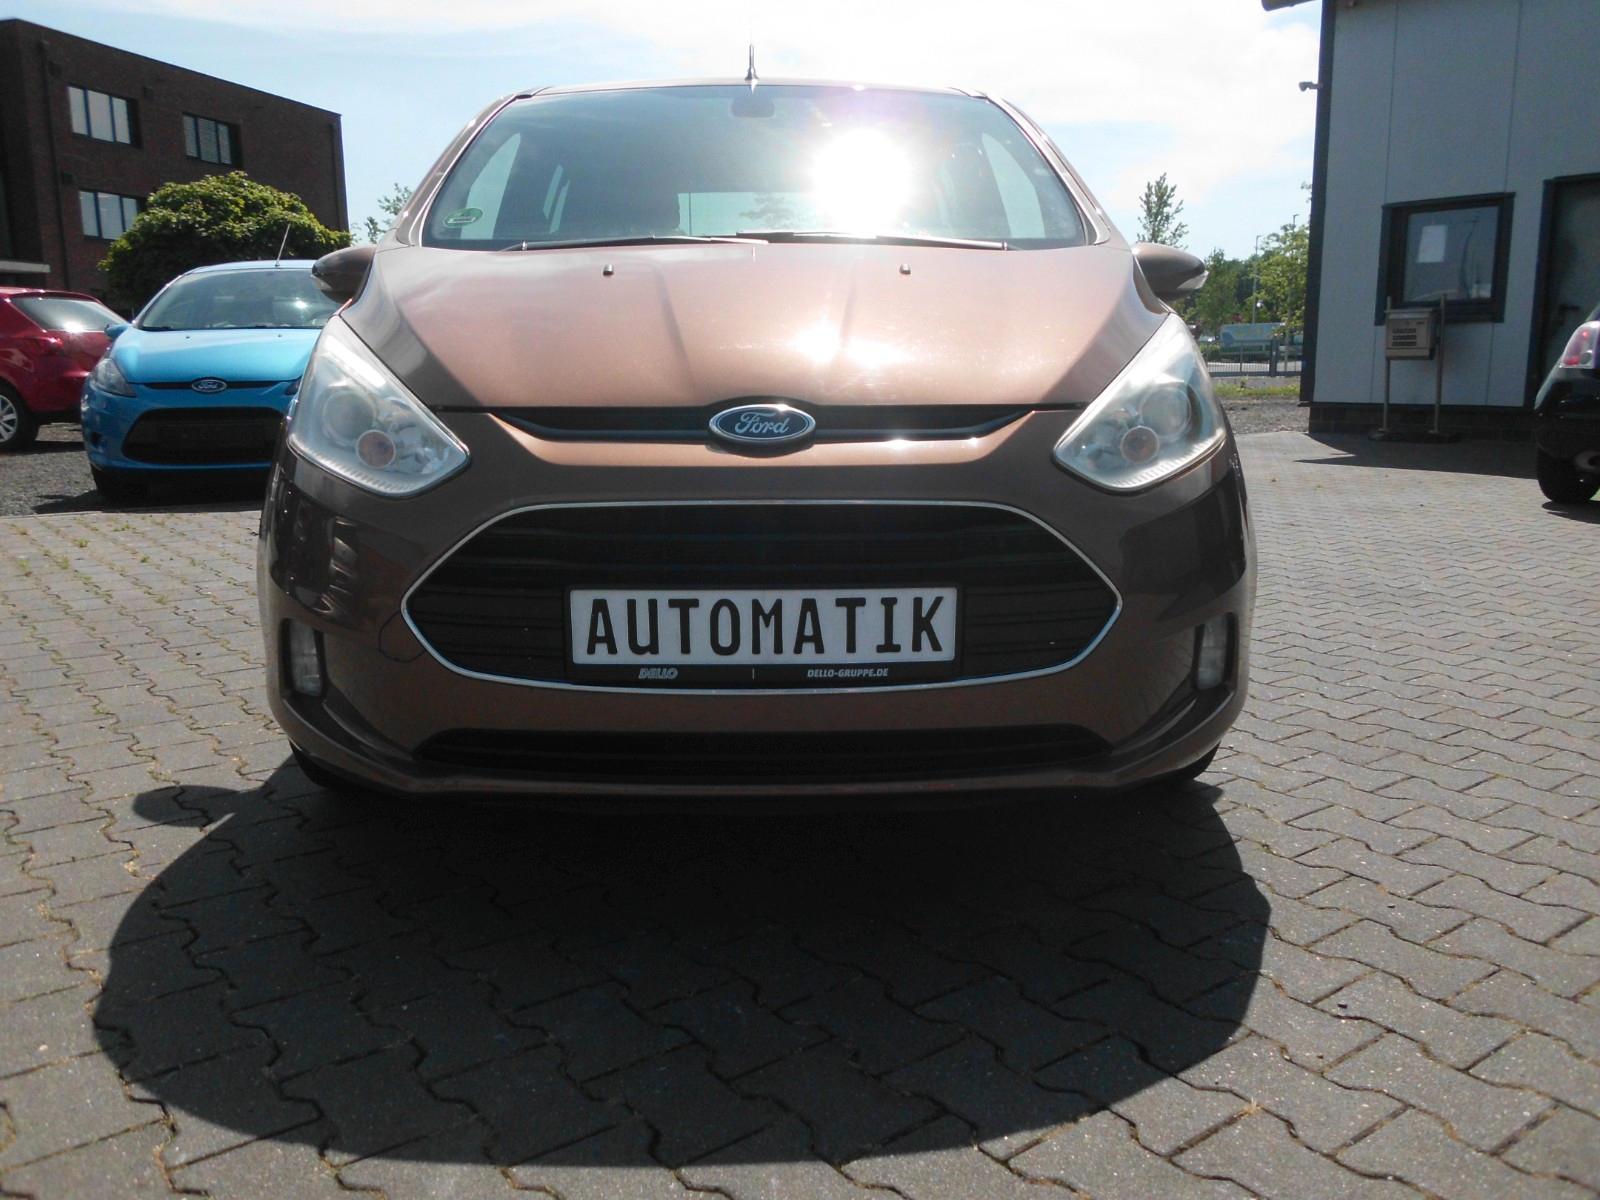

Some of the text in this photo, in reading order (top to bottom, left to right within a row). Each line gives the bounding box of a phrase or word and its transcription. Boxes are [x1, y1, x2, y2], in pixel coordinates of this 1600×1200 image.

[735, 411, 790, 433] Ford
[587, 597, 944, 655] AUTOMATIK
[638, 667, 678, 680] DELLO
[807, 667, 889, 678] DELLO-GRUPPE.DE
